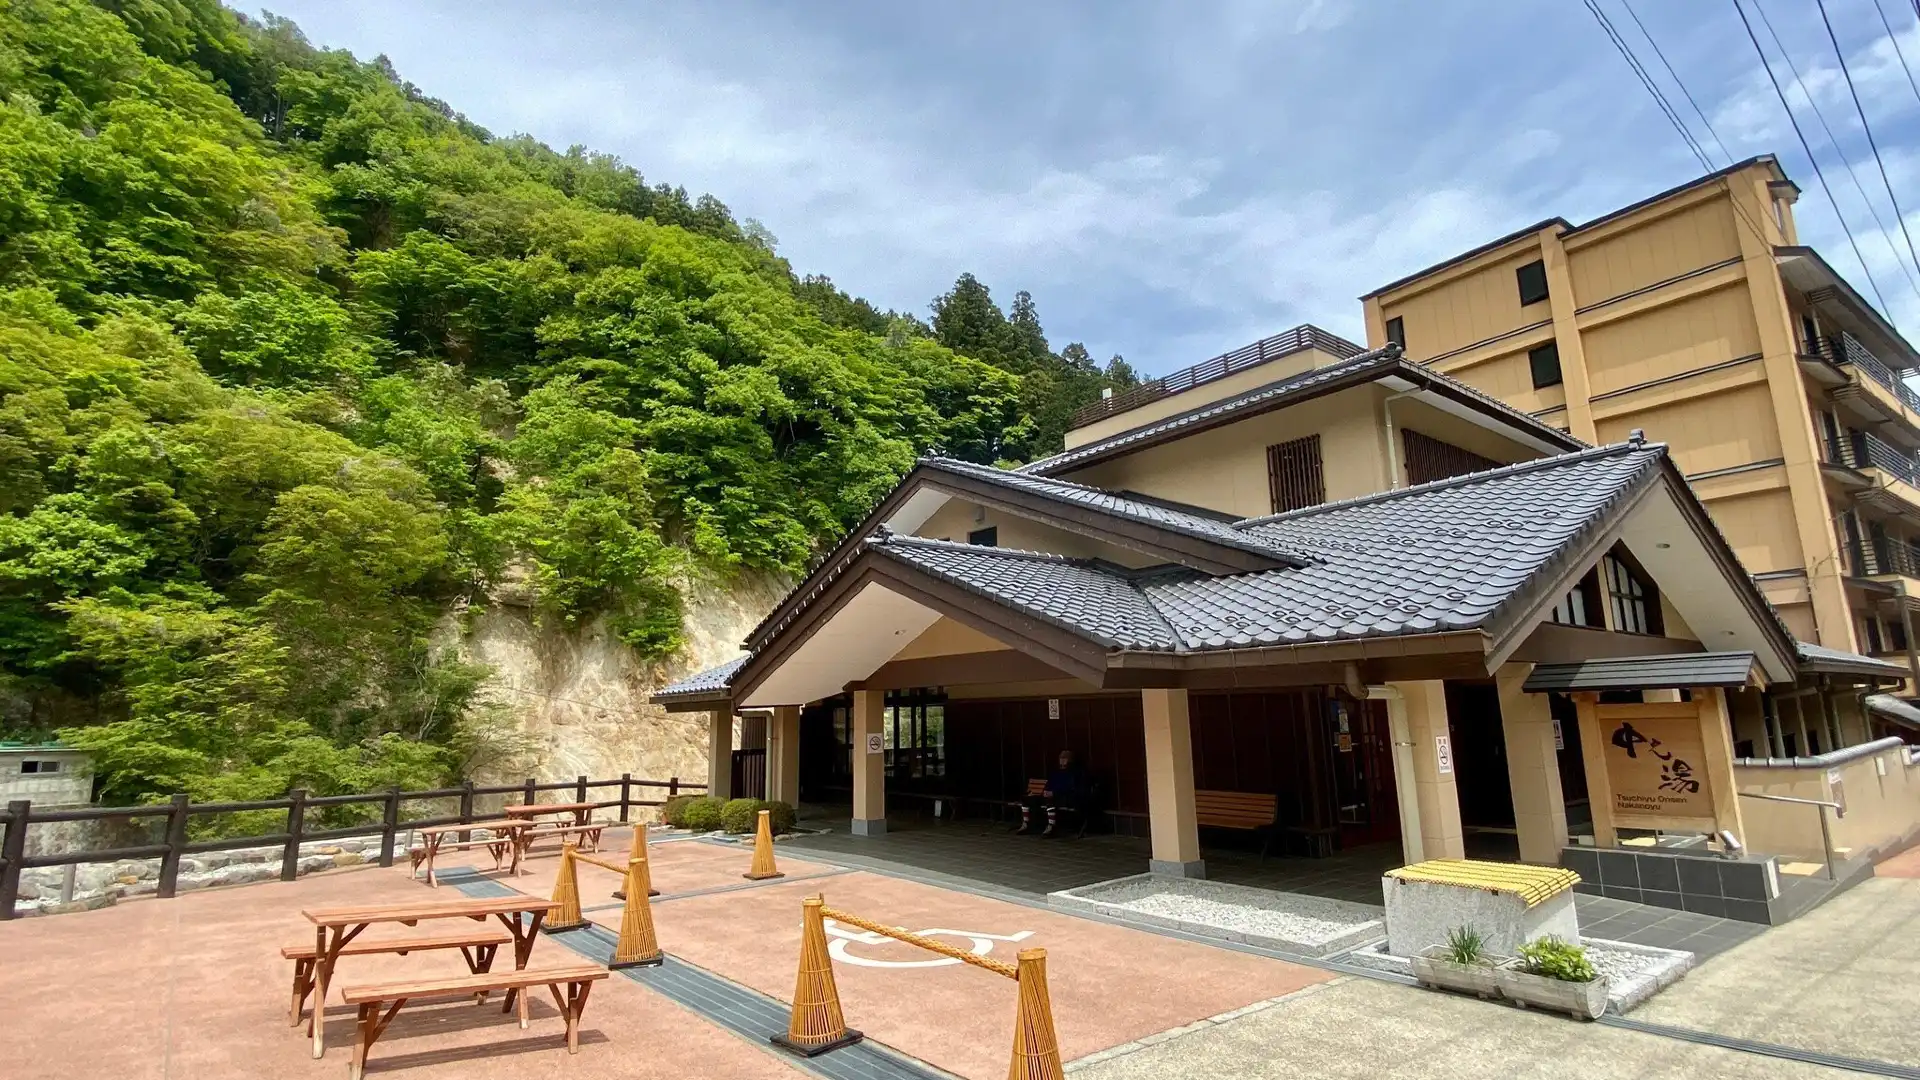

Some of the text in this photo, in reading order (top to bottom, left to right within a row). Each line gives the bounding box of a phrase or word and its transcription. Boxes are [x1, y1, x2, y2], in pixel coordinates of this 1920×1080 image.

[1616, 793, 1688, 803] Tsuchiyu Onsen
[1617, 802, 1661, 810] Nakanoyu
